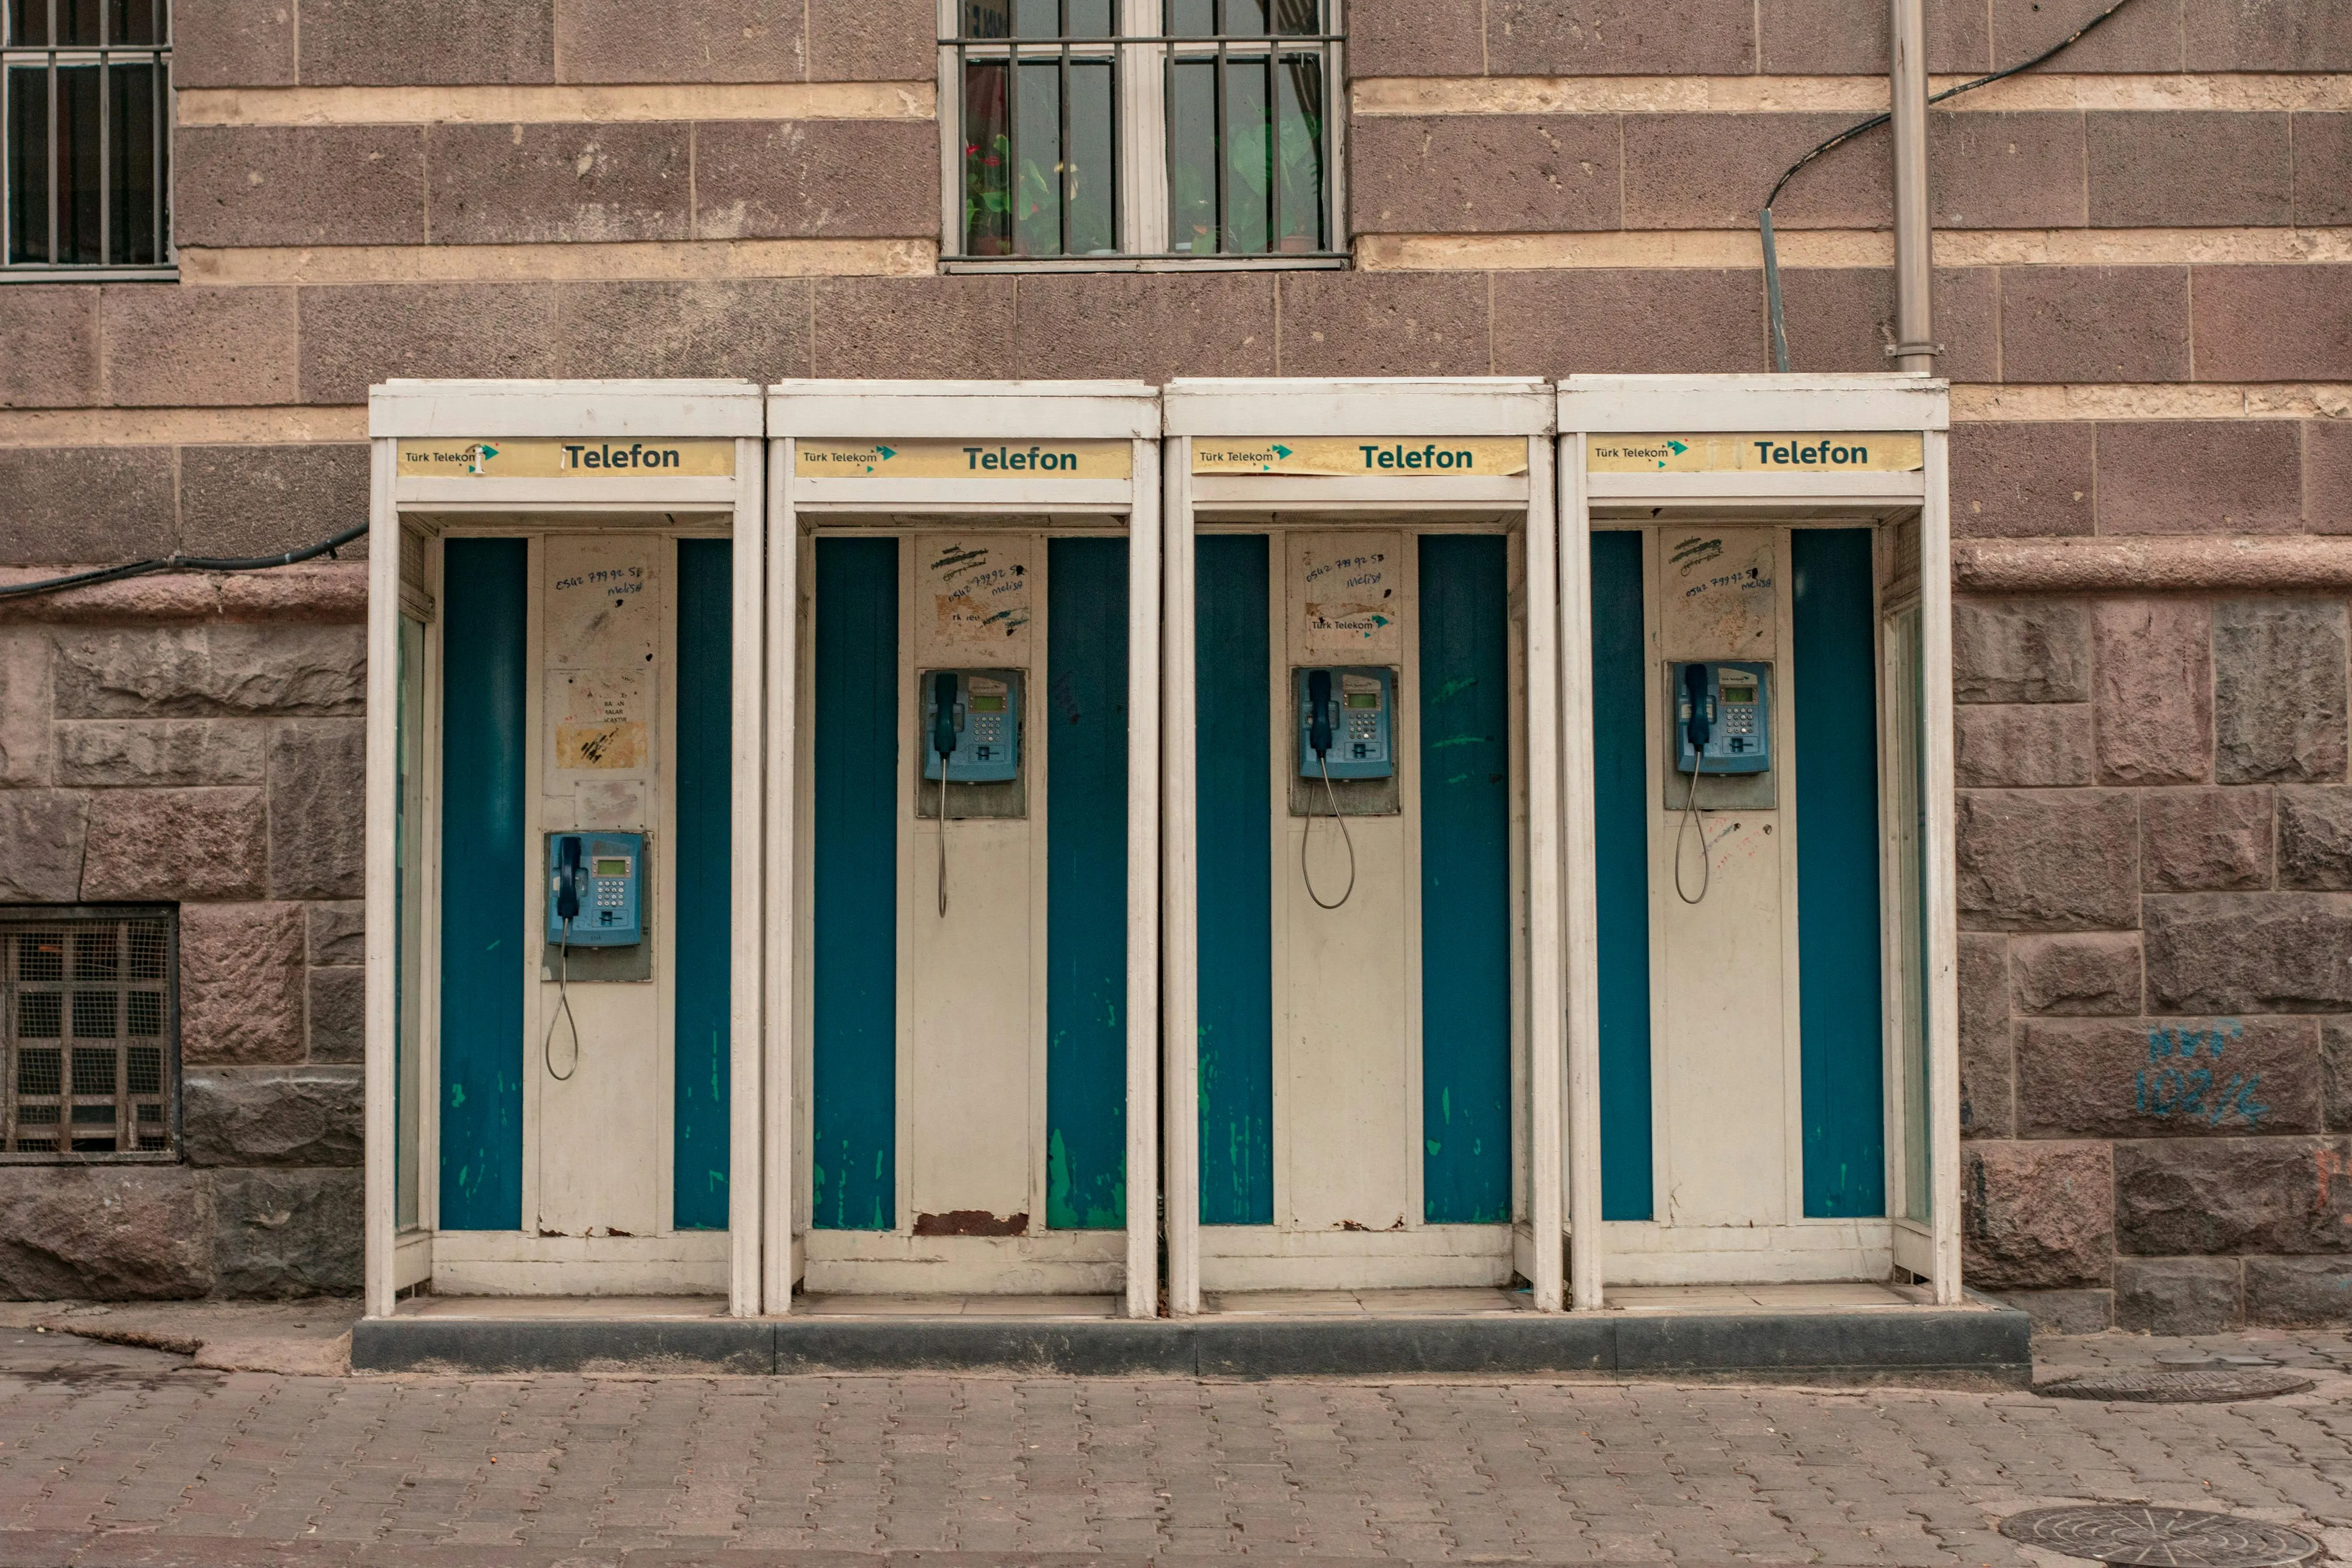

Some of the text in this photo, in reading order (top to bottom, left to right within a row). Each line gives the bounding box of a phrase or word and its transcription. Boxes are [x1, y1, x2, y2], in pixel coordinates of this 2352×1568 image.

[406, 452, 429, 462] Türk
[565, 444, 679, 468] Telefon
[804, 452, 877, 462] Türk Telekom
[1200, 452, 1273, 461] Türk Telekom
[1359, 445, 1472, 468] Telefon
[1595, 448, 1668, 457] Türk Telekom
[1754, 441, 1867, 464] Telefon
[963, 447, 1077, 470] Telefon
[1312, 620, 1373, 629] Türk Telekom
